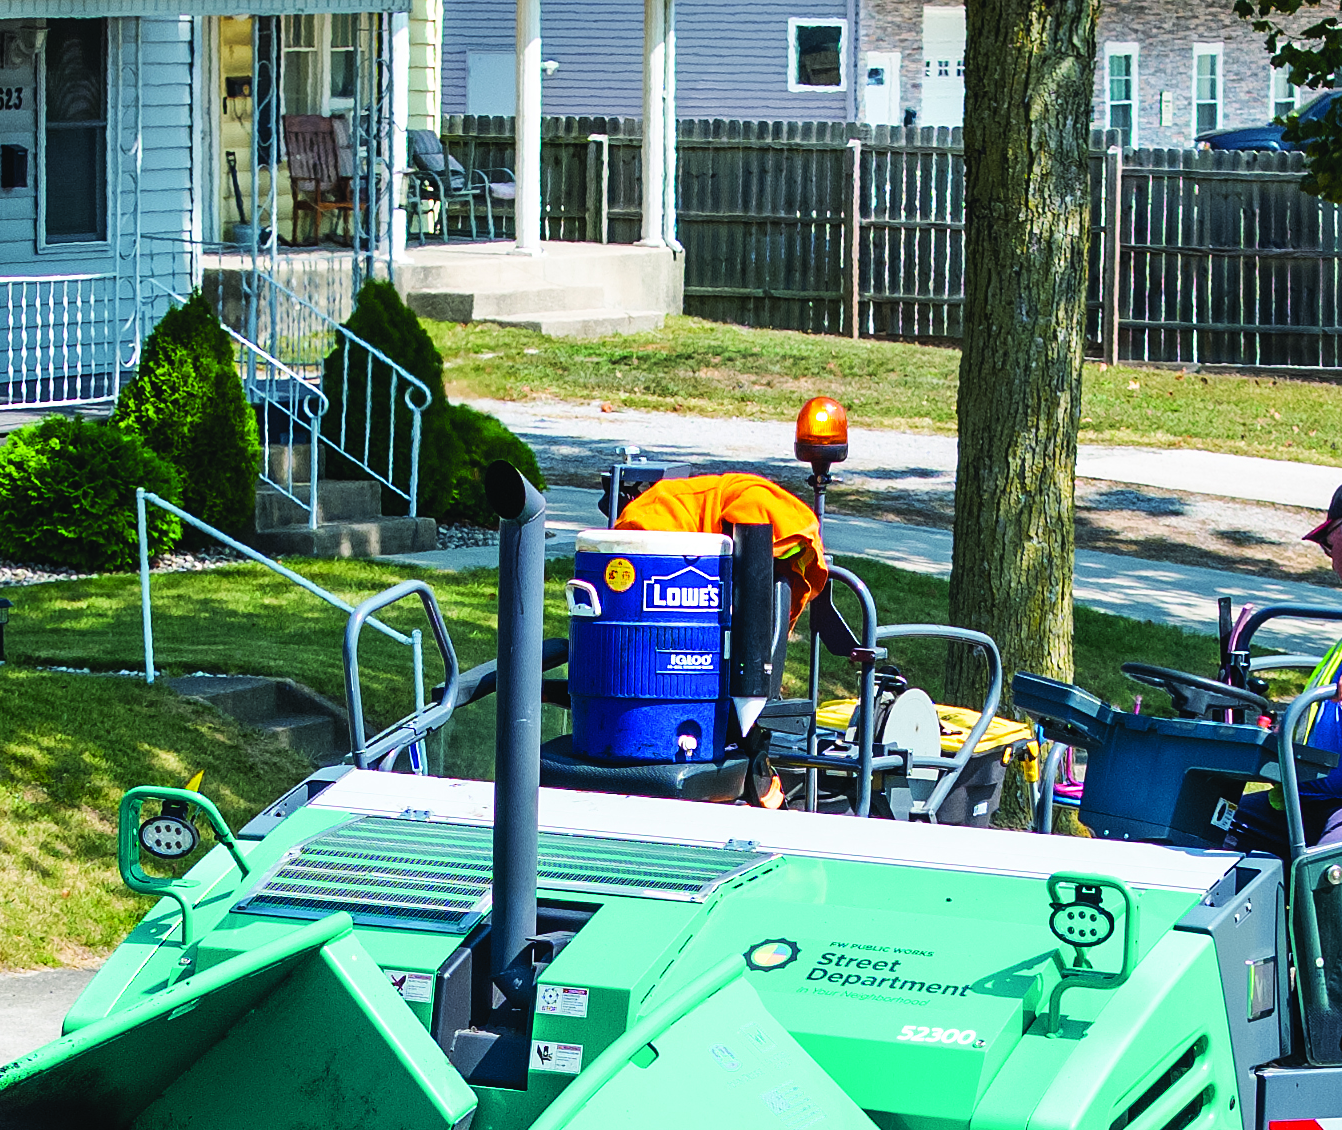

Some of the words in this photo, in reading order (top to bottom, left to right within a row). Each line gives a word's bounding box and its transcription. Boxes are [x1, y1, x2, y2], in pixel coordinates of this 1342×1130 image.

[850, 943, 891, 953] PUBLIC
[893, 947, 935, 957] WORKS
[816, 952, 902, 973] Street
[805, 967, 973, 997] Department
[840, 990, 931, 1007] Neighborhood
